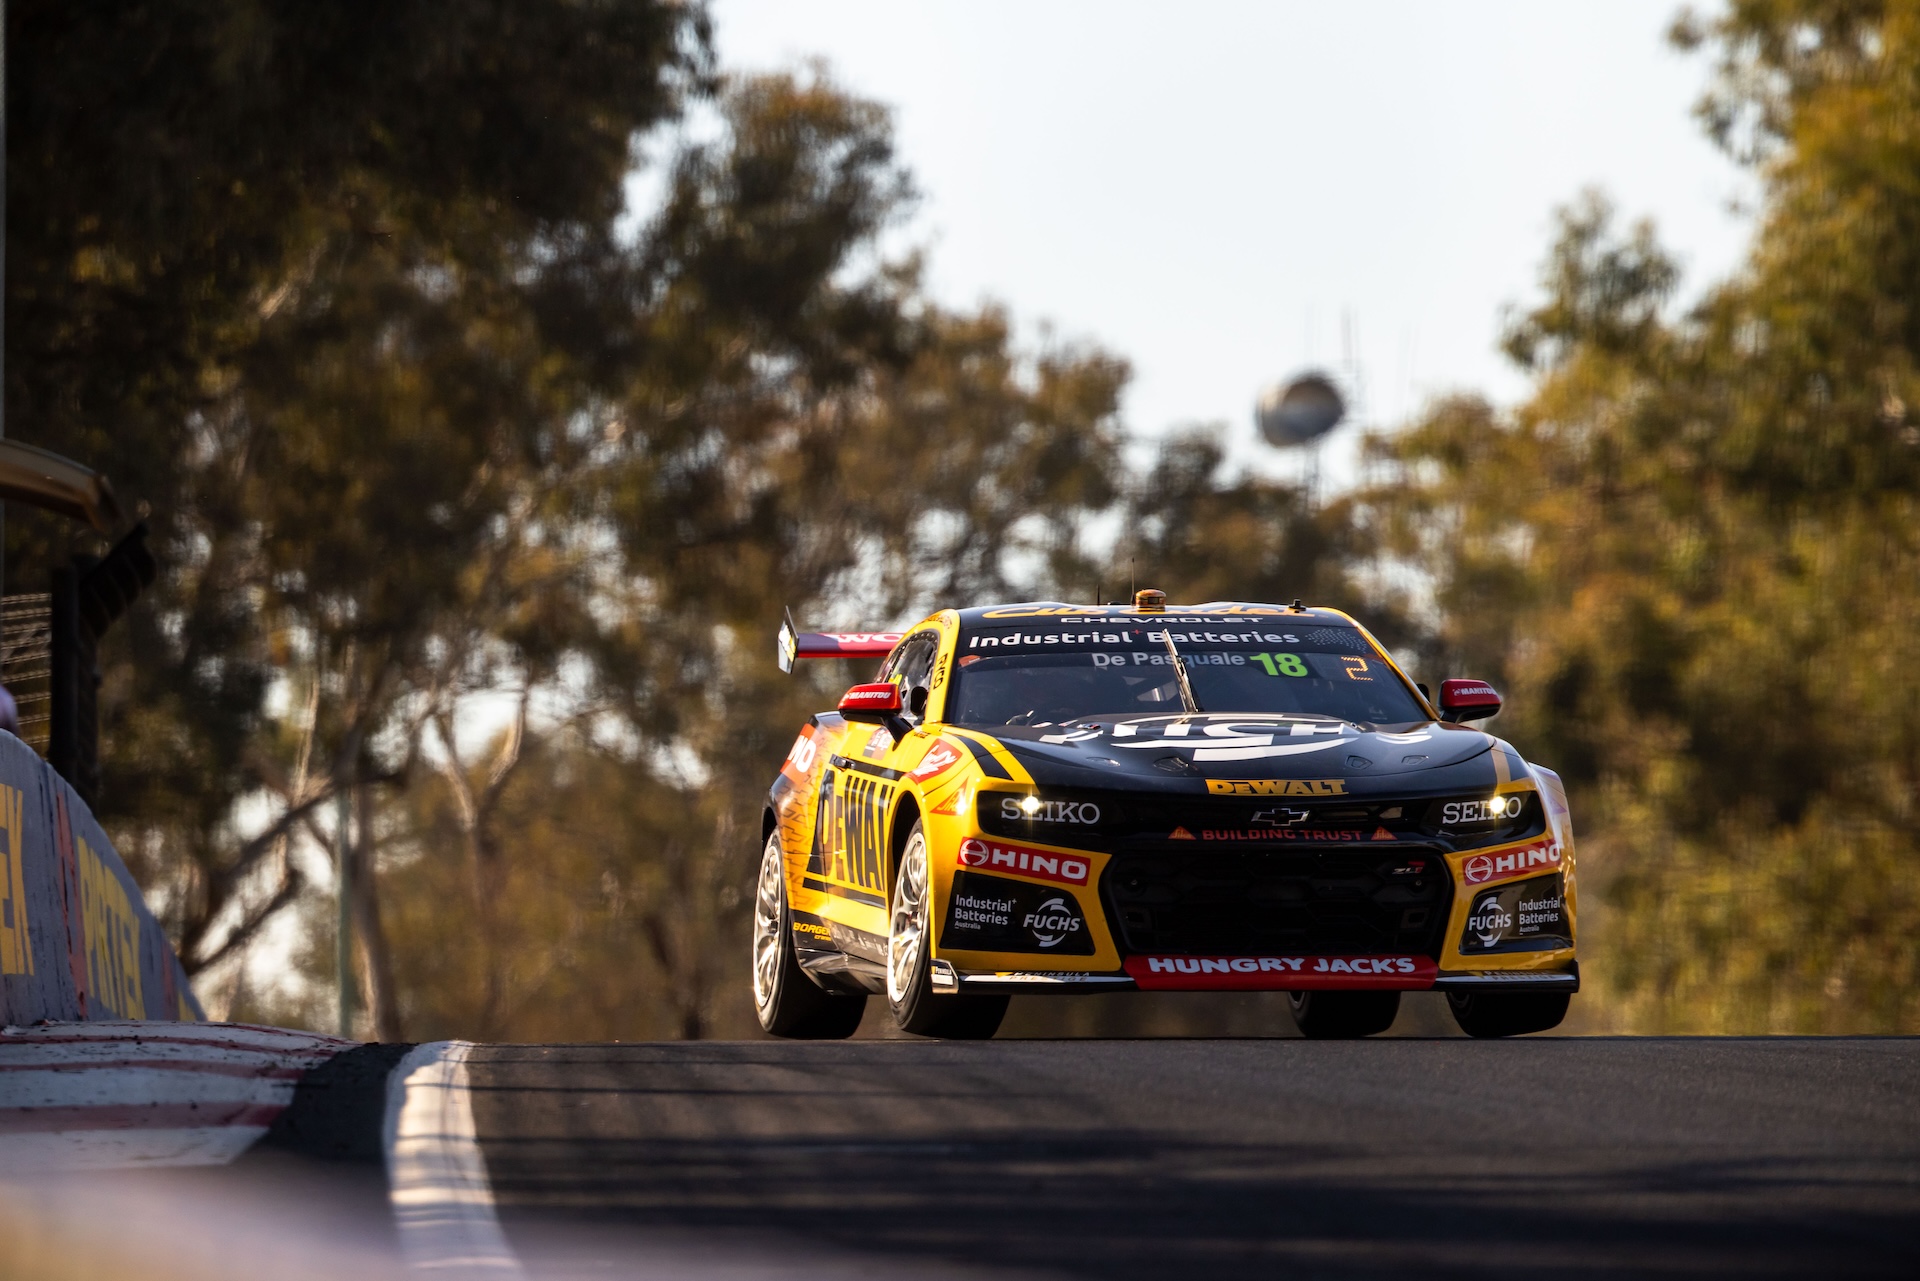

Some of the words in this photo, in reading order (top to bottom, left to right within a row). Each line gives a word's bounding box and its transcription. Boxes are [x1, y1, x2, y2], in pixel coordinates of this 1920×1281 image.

[969, 631, 1133, 648] Industrial
[1147, 630, 1300, 644] Batteries
[1092, 652, 1126, 667] De
[1132, 652, 1246, 669] Pasquale
[1250, 652, 1308, 677] 18
[1341, 656, 1374, 681] 2
[848, 691, 892, 700] MANITOU
[1202, 829, 1296, 841] BUILDING
[1298, 829, 1363, 841] TRUST
[992, 848, 1087, 880] HINO
[1496, 844, 1561, 873] HINO
[955, 894, 1012, 912] Industrial
[1519, 898, 1561, 912] Industrial
[955, 908, 1008, 925] Batteries
[1023, 913, 1080, 932] FUCHS
[1468, 913, 1512, 931] FUCHS
[1519, 911, 1559, 925] Batteries
[1148, 957, 1305, 973] HUNGRY
[1313, 957, 1415, 973] JACK'S
